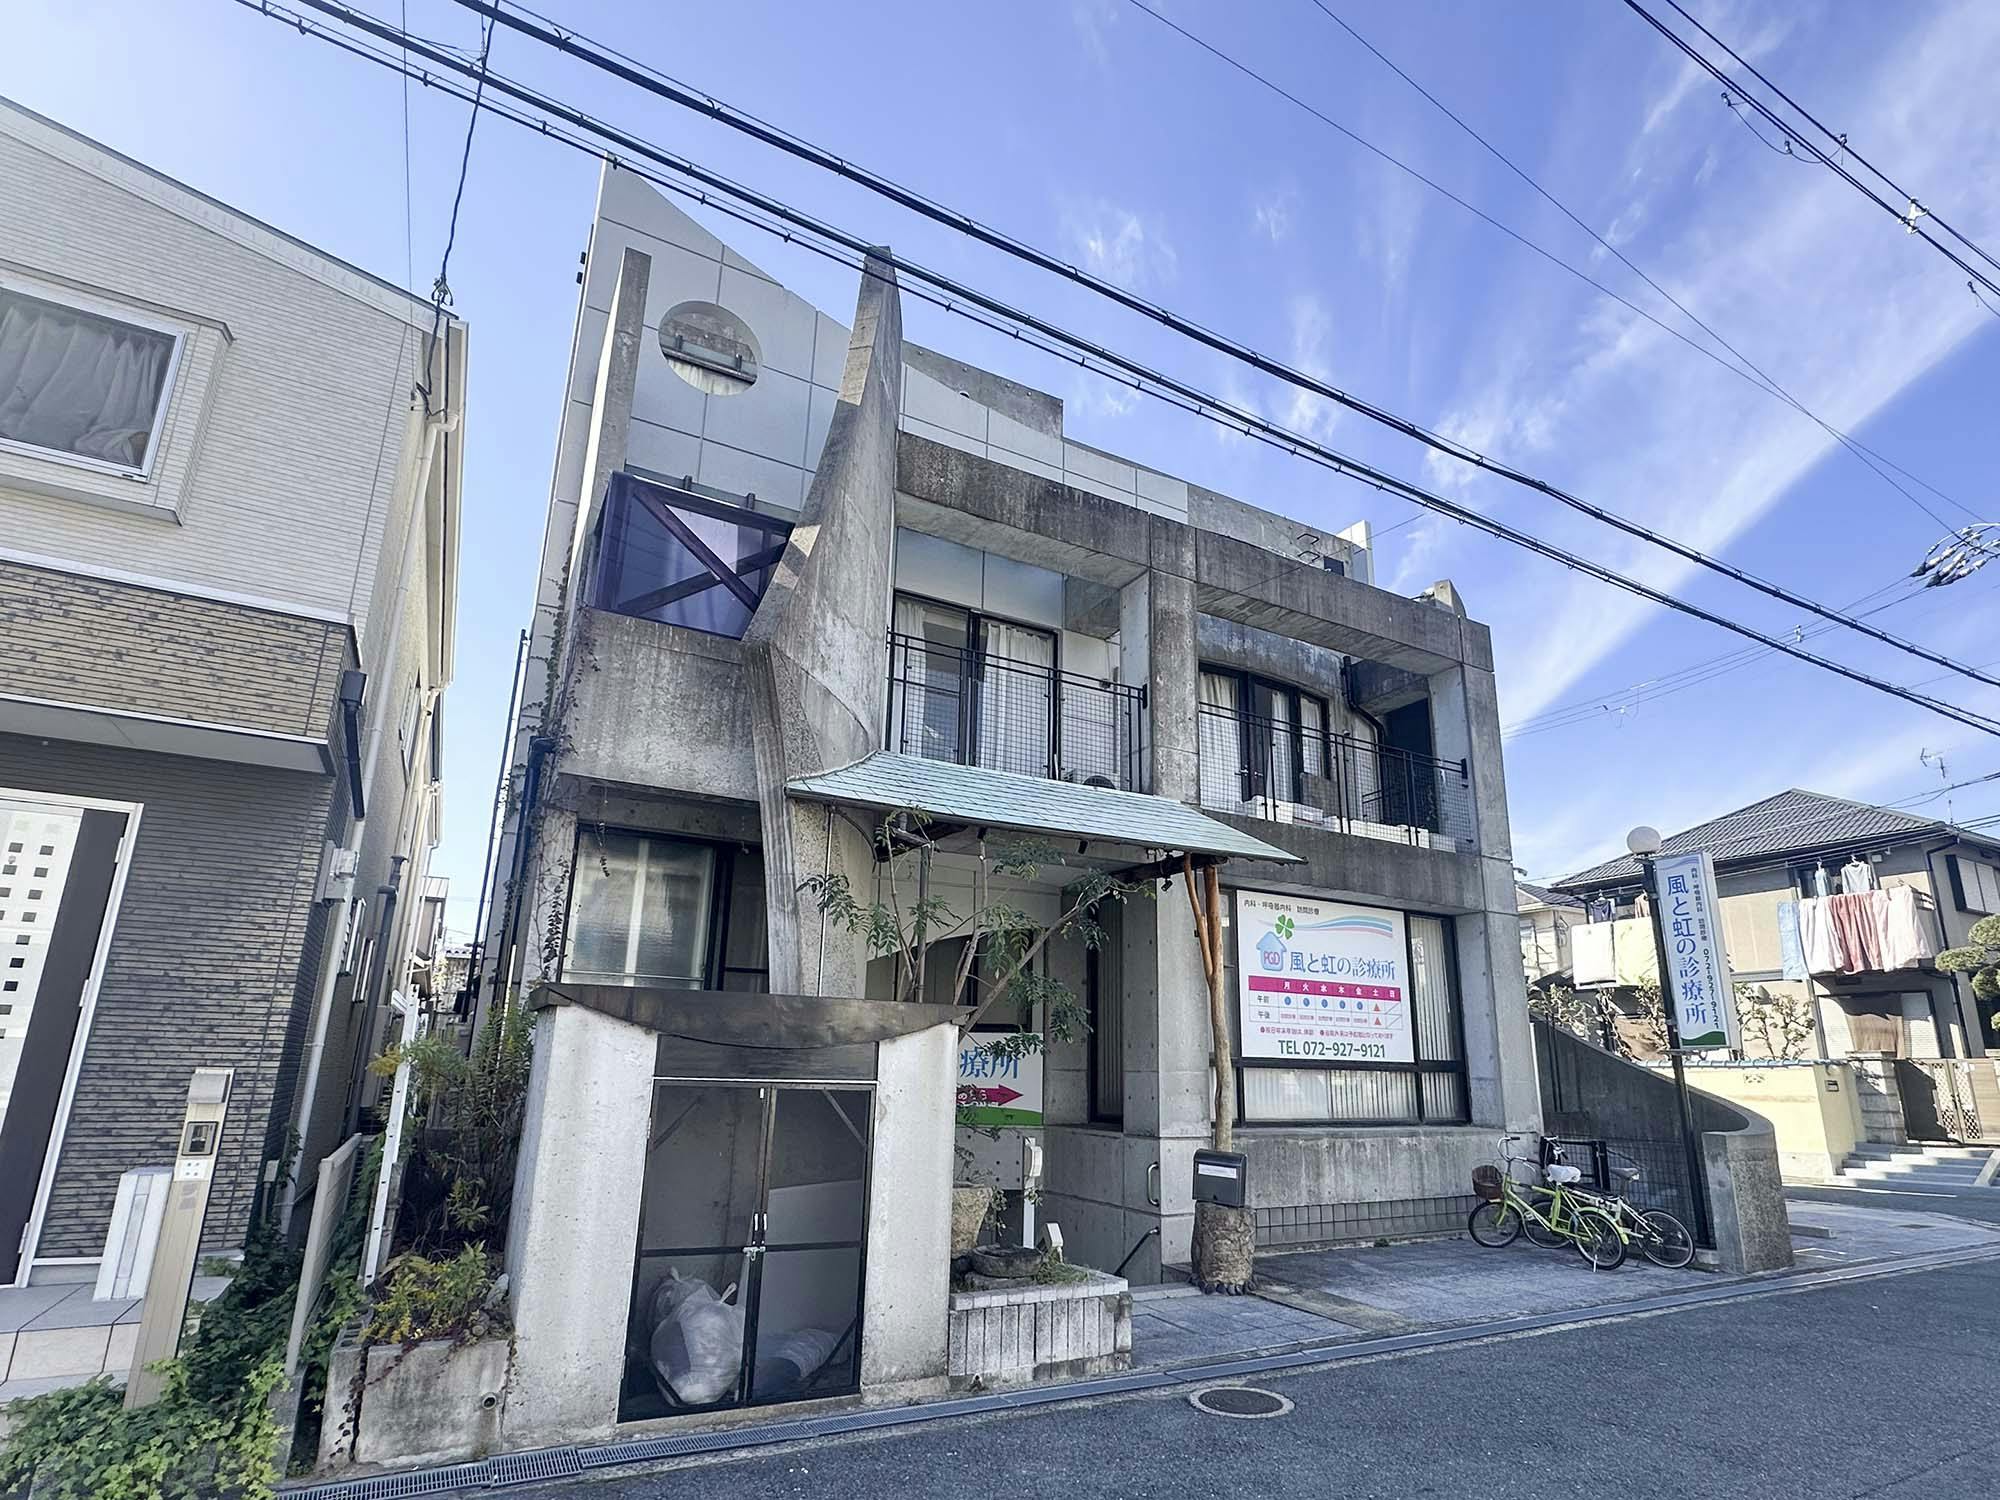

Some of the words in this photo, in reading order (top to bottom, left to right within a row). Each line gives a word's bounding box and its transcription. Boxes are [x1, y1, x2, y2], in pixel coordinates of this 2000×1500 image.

[1667, 874, 1706, 1024] 風と虹の診療所
[1289, 951, 1395, 980] 風と虹の診療所
[1257, 995, 1270, 1004] 午前
[1283, 982, 1291, 990] 月
[1302, 983, 1310, 992] 火
[1320, 984, 1328, 993] 水
[1338, 985, 1345, 994] 木
[1355, 986, 1363, 995] 金
[1372, 988, 1379, 997] 土
[1389, 990, 1395, 998] 日
[1703, 948, 1719, 1029] 072-927-9121
[1278, 1039, 1300, 1055] TEL
[1303, 1040, 1385, 1058] 072-927-9121
